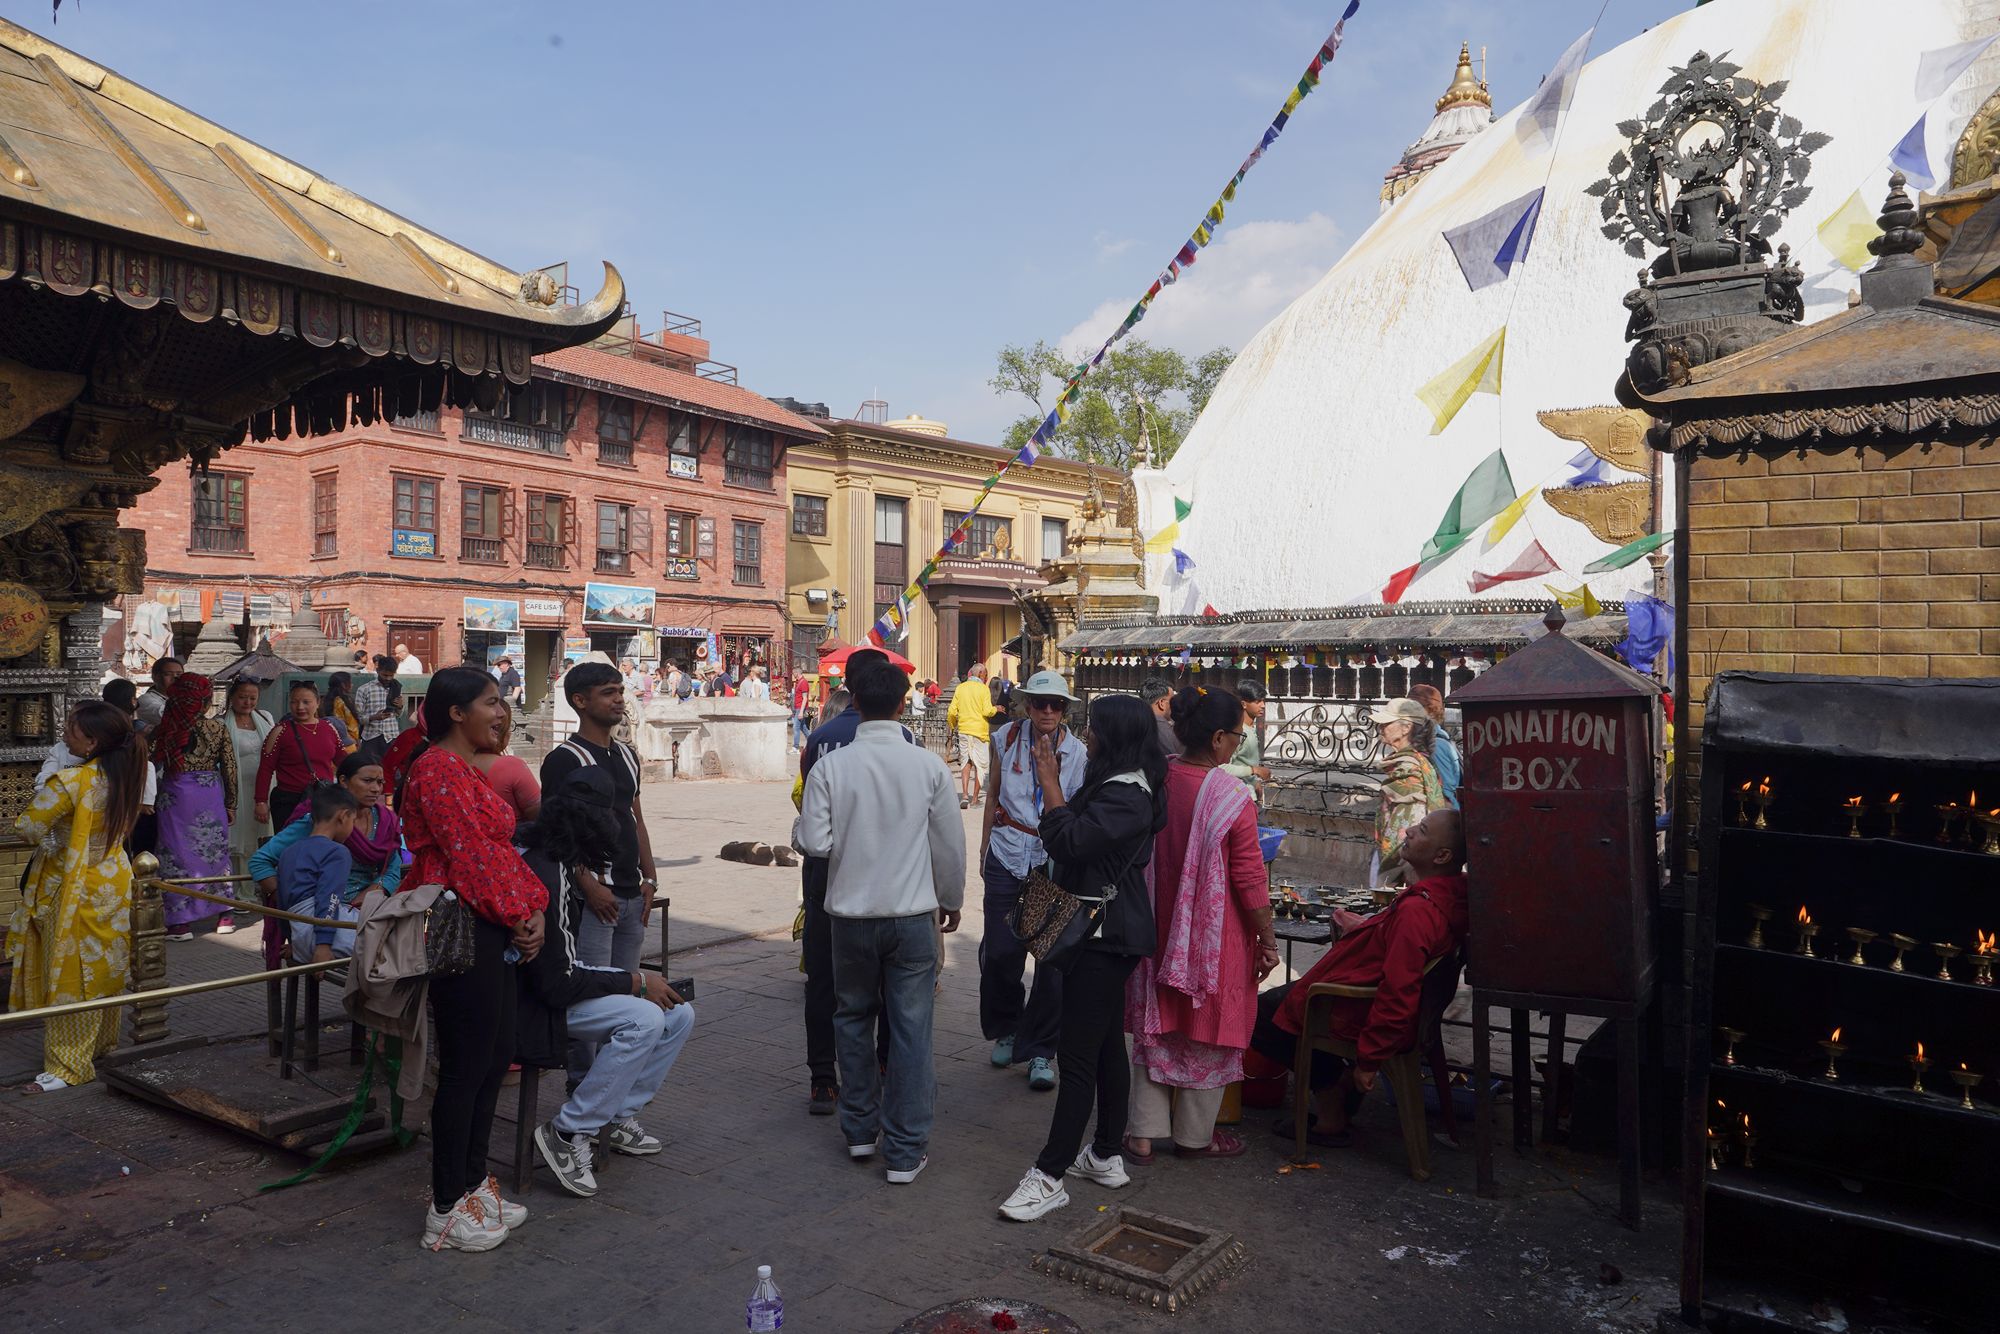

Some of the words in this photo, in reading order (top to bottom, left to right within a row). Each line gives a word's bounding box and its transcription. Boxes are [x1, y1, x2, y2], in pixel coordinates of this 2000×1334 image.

[662, 627, 689, 636] Bubble
[690, 628, 702, 637] Tea
[1467, 709, 1617, 755] DONATION
[1502, 757, 1582, 791] BOX
